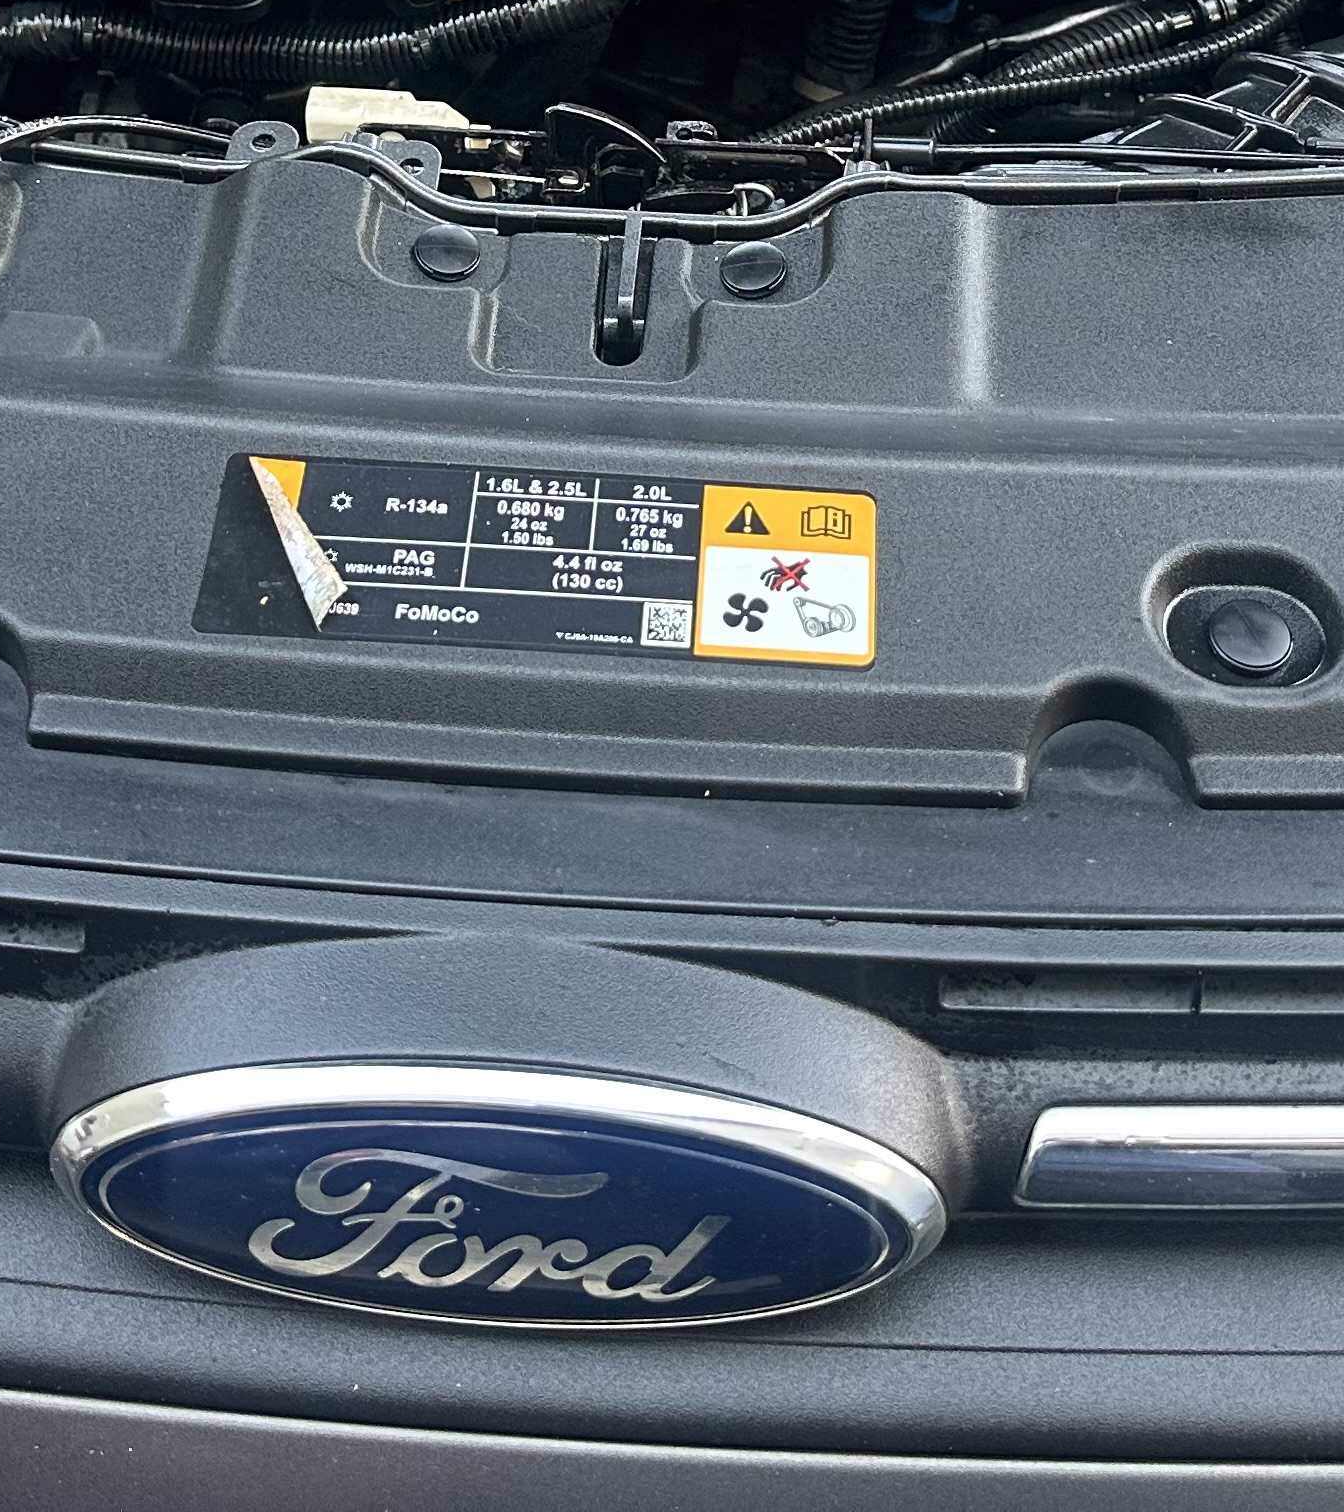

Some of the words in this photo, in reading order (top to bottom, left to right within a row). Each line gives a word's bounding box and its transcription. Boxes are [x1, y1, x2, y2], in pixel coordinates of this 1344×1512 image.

[486, 476, 524, 494] 1.6L
[528, 479, 543, 495] &
[547, 481, 588, 497] 2.5L
[632, 484, 673, 501] 2.0L
[385, 497, 449, 515] R-134a
[496, 499, 541, 517] 0.680
[543, 502, 565, 521] kg
[510, 516, 528, 531] 24
[529, 519, 548, 532] oz
[615, 506, 660, 524] 0.765
[662, 509, 684, 528] kg
[501, 531, 530, 545] 1.50
[532, 532, 554, 547] lbs
[629, 523, 647, 538] 27
[649, 527, 667, 539] oz
[621, 538, 650, 553] 1.69
[652, 539, 674, 554] lbs
[392, 549, 436, 566] PAG
[552, 554, 580, 571] 4.4
[584, 555, 597, 571] fl
[600, 559, 624, 573] oz
[551, 571, 592, 590] (130
[594, 574, 624, 594] cc)
[394, 603, 480, 624] FoMoCo
[246, 1147, 732, 1301] Ford
